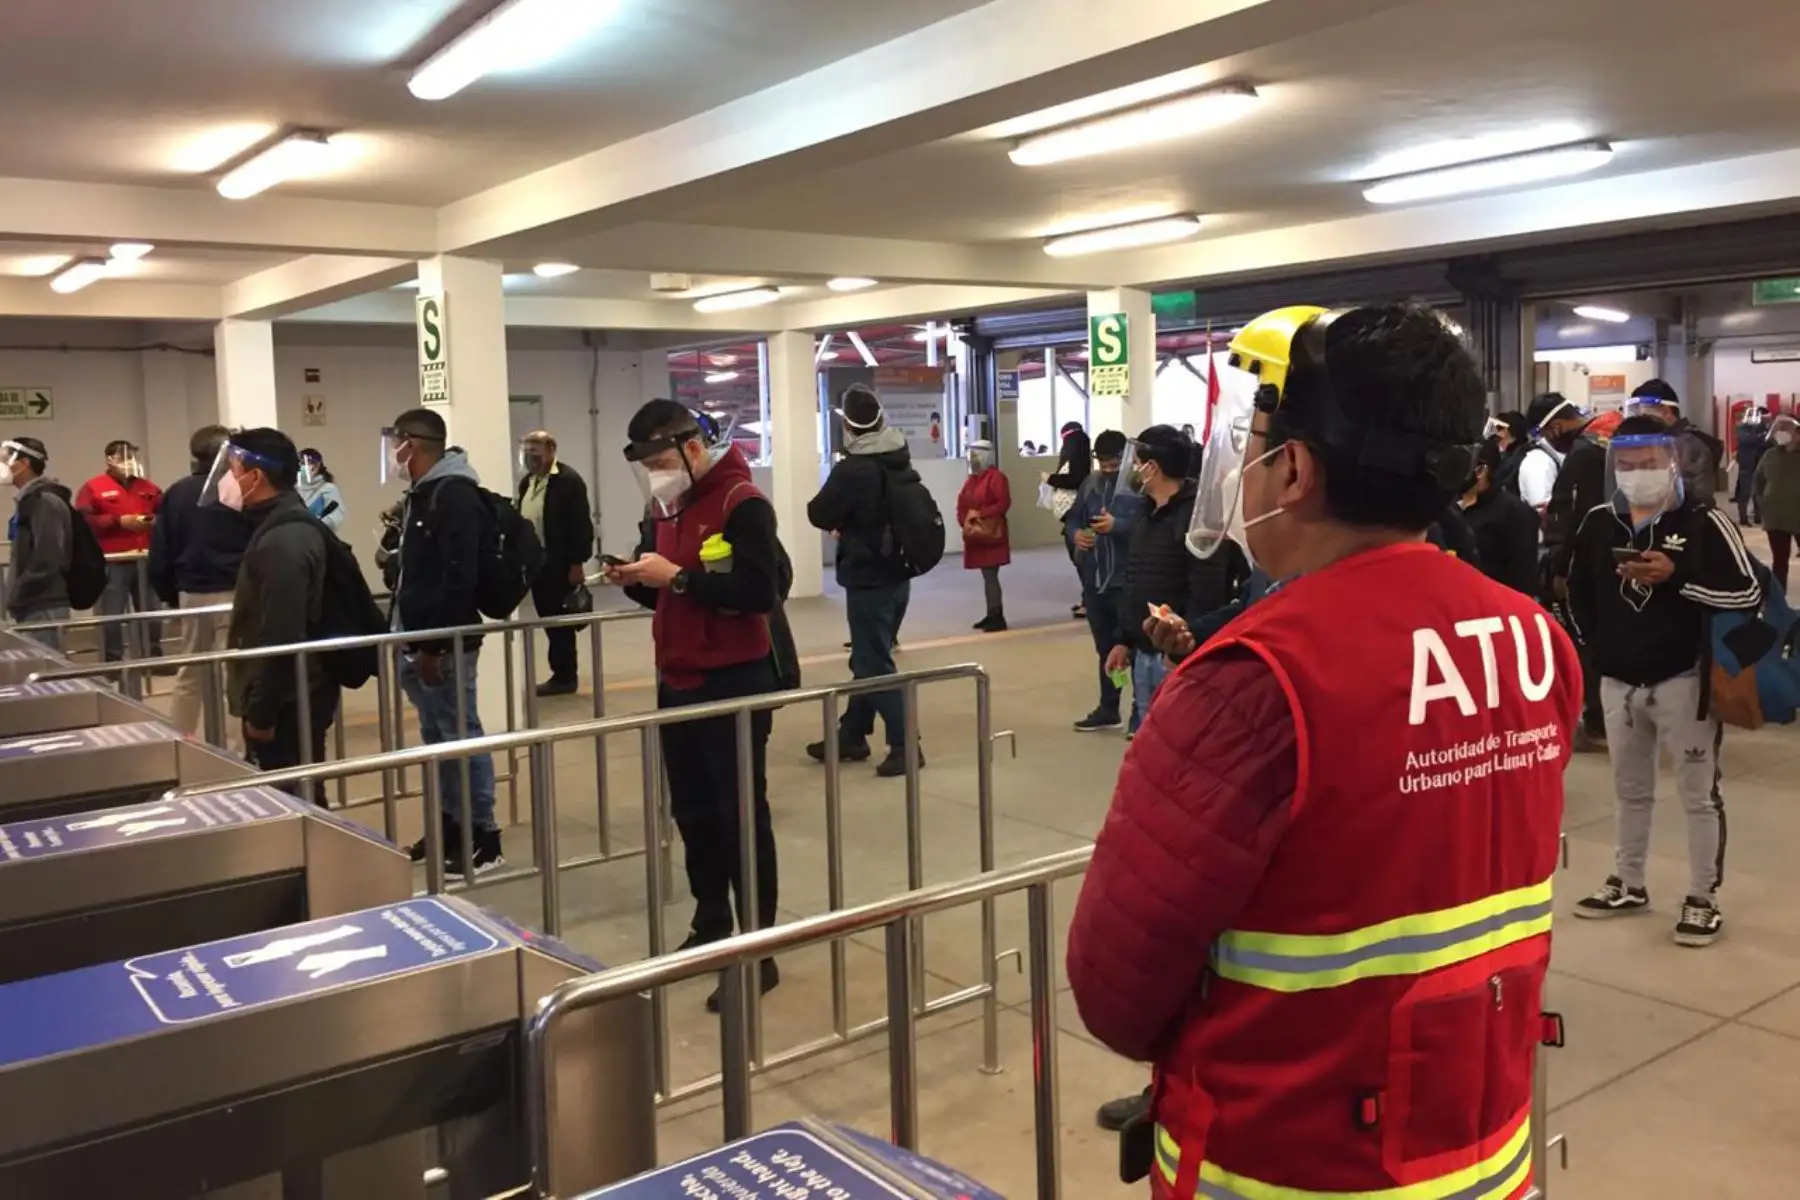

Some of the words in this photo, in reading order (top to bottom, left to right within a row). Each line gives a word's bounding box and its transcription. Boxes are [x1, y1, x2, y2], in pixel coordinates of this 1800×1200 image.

[423, 300, 441, 361] S
[1097, 316, 1122, 363] S
[1408, 613, 1555, 725] ATU
[1405, 736, 1485, 771] Autoridad
[1486, 732, 1501, 752] de
[1399, 773, 1462, 794] Urbano
[1494, 753, 1527, 771] Lima
[729, 1150, 777, 1184] hand,
[770, 1148, 806, 1173] left.
[800, 1168, 832, 1190] the
